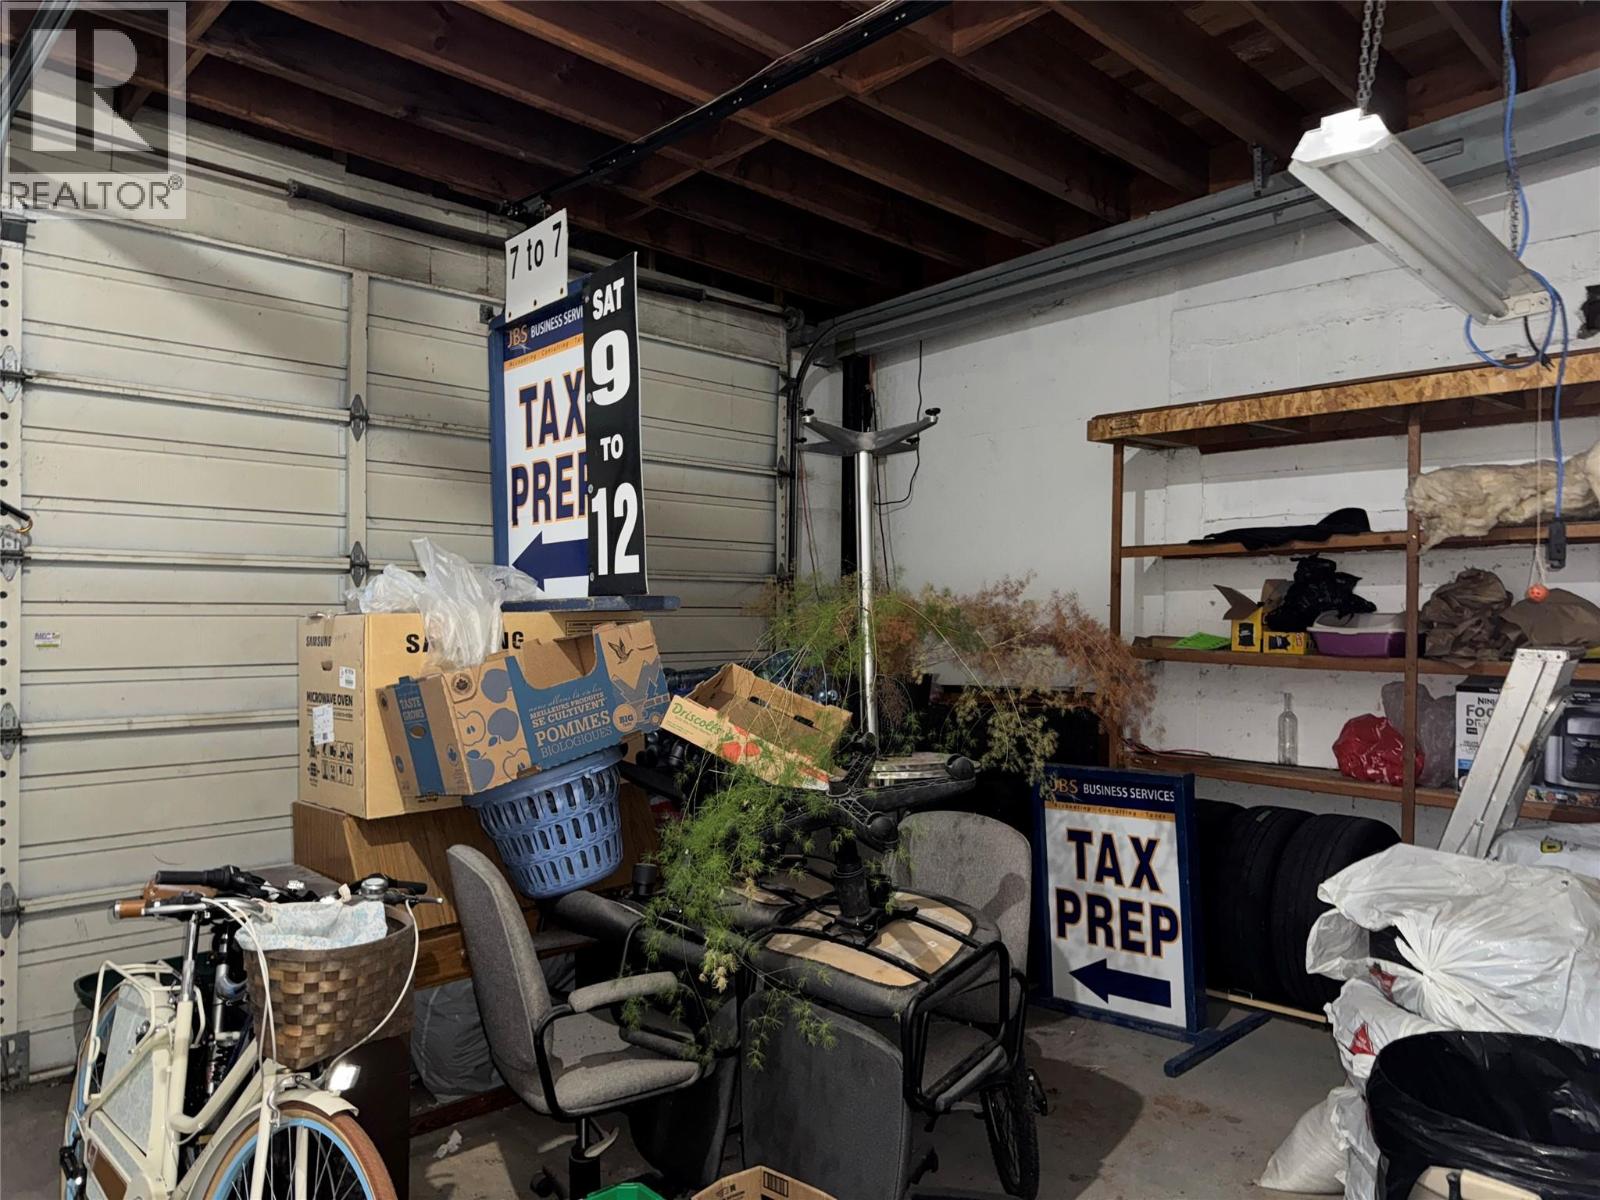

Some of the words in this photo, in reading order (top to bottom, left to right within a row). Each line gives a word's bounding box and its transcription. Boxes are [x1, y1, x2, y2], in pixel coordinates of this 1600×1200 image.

[510, 245, 519, 280] 7
[527, 239, 543, 271] to
[553, 220, 562, 258] 7
[592, 277, 625, 320] SAT
[507, 324, 528, 349] JBS
[531, 313, 563, 338] BUSINESS
[563, 305, 584, 325] SERVI
[591, 329, 630, 406] 9
[519, 368, 586, 450] TAX
[600, 433, 624, 461] TO
[591, 482, 640, 576] 12
[306, 636, 332, 648] SAMSUNG
[306, 691, 337, 705] MICROWAVE
[337, 694, 353, 706] OVEN
[530, 702, 570, 720] MEILLEURS
[570, 692, 604, 708] PRODUITS
[531, 716, 546, 729] SE
[547, 698, 606, 723] CULTIVENT
[1478, 697, 1497, 706] NINJ
[534, 710, 611, 747] POMMES
[541, 726, 613, 759] BIOLOGIQUES
[1051, 779, 1078, 794] JBS
[1083, 783, 1128, 798] BUSINESS
[1130, 787, 1175, 802] SERVICES
[1066, 828, 1162, 893] TAX
[1055, 887, 1179, 959] PREP
